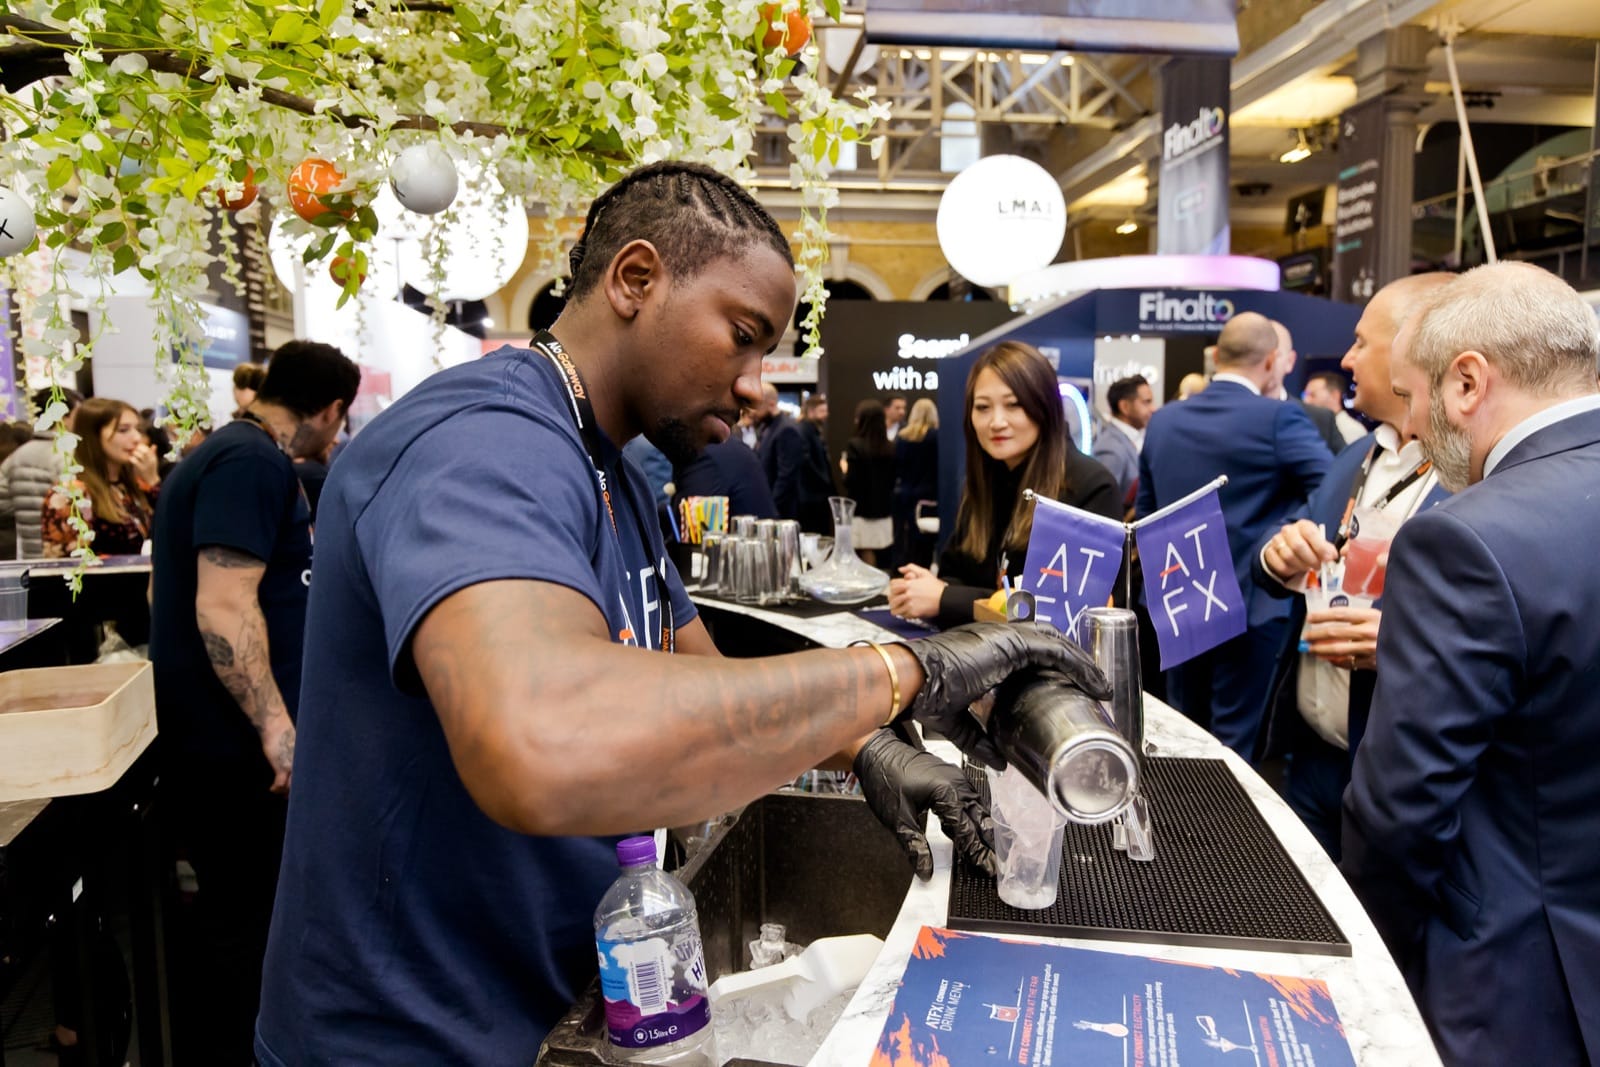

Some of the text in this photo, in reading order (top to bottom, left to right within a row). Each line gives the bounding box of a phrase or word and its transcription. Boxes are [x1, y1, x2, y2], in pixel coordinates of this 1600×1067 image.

[1164, 107, 1225, 160] Finalto
[1139, 291, 1235, 322] Finalto
[872, 366, 939, 390] with a
[1036, 543, 1105, 597] AT
[1160, 523, 1208, 590] AT
[1163, 570, 1229, 638] FX
[1028, 988, 1037, 998] THE
[1030, 976, 1038, 987] FAIR
[940, 981, 964, 1031] DRINK MENU
[1025, 1007, 1034, 1018] FUN
[1133, 994, 1143, 1029] ELECTRICITY
[1021, 1019, 1032, 1046] CONNECT
[1134, 1030, 1144, 1059] CONNECT
[1019, 1047, 1029, 1064] ATFX
